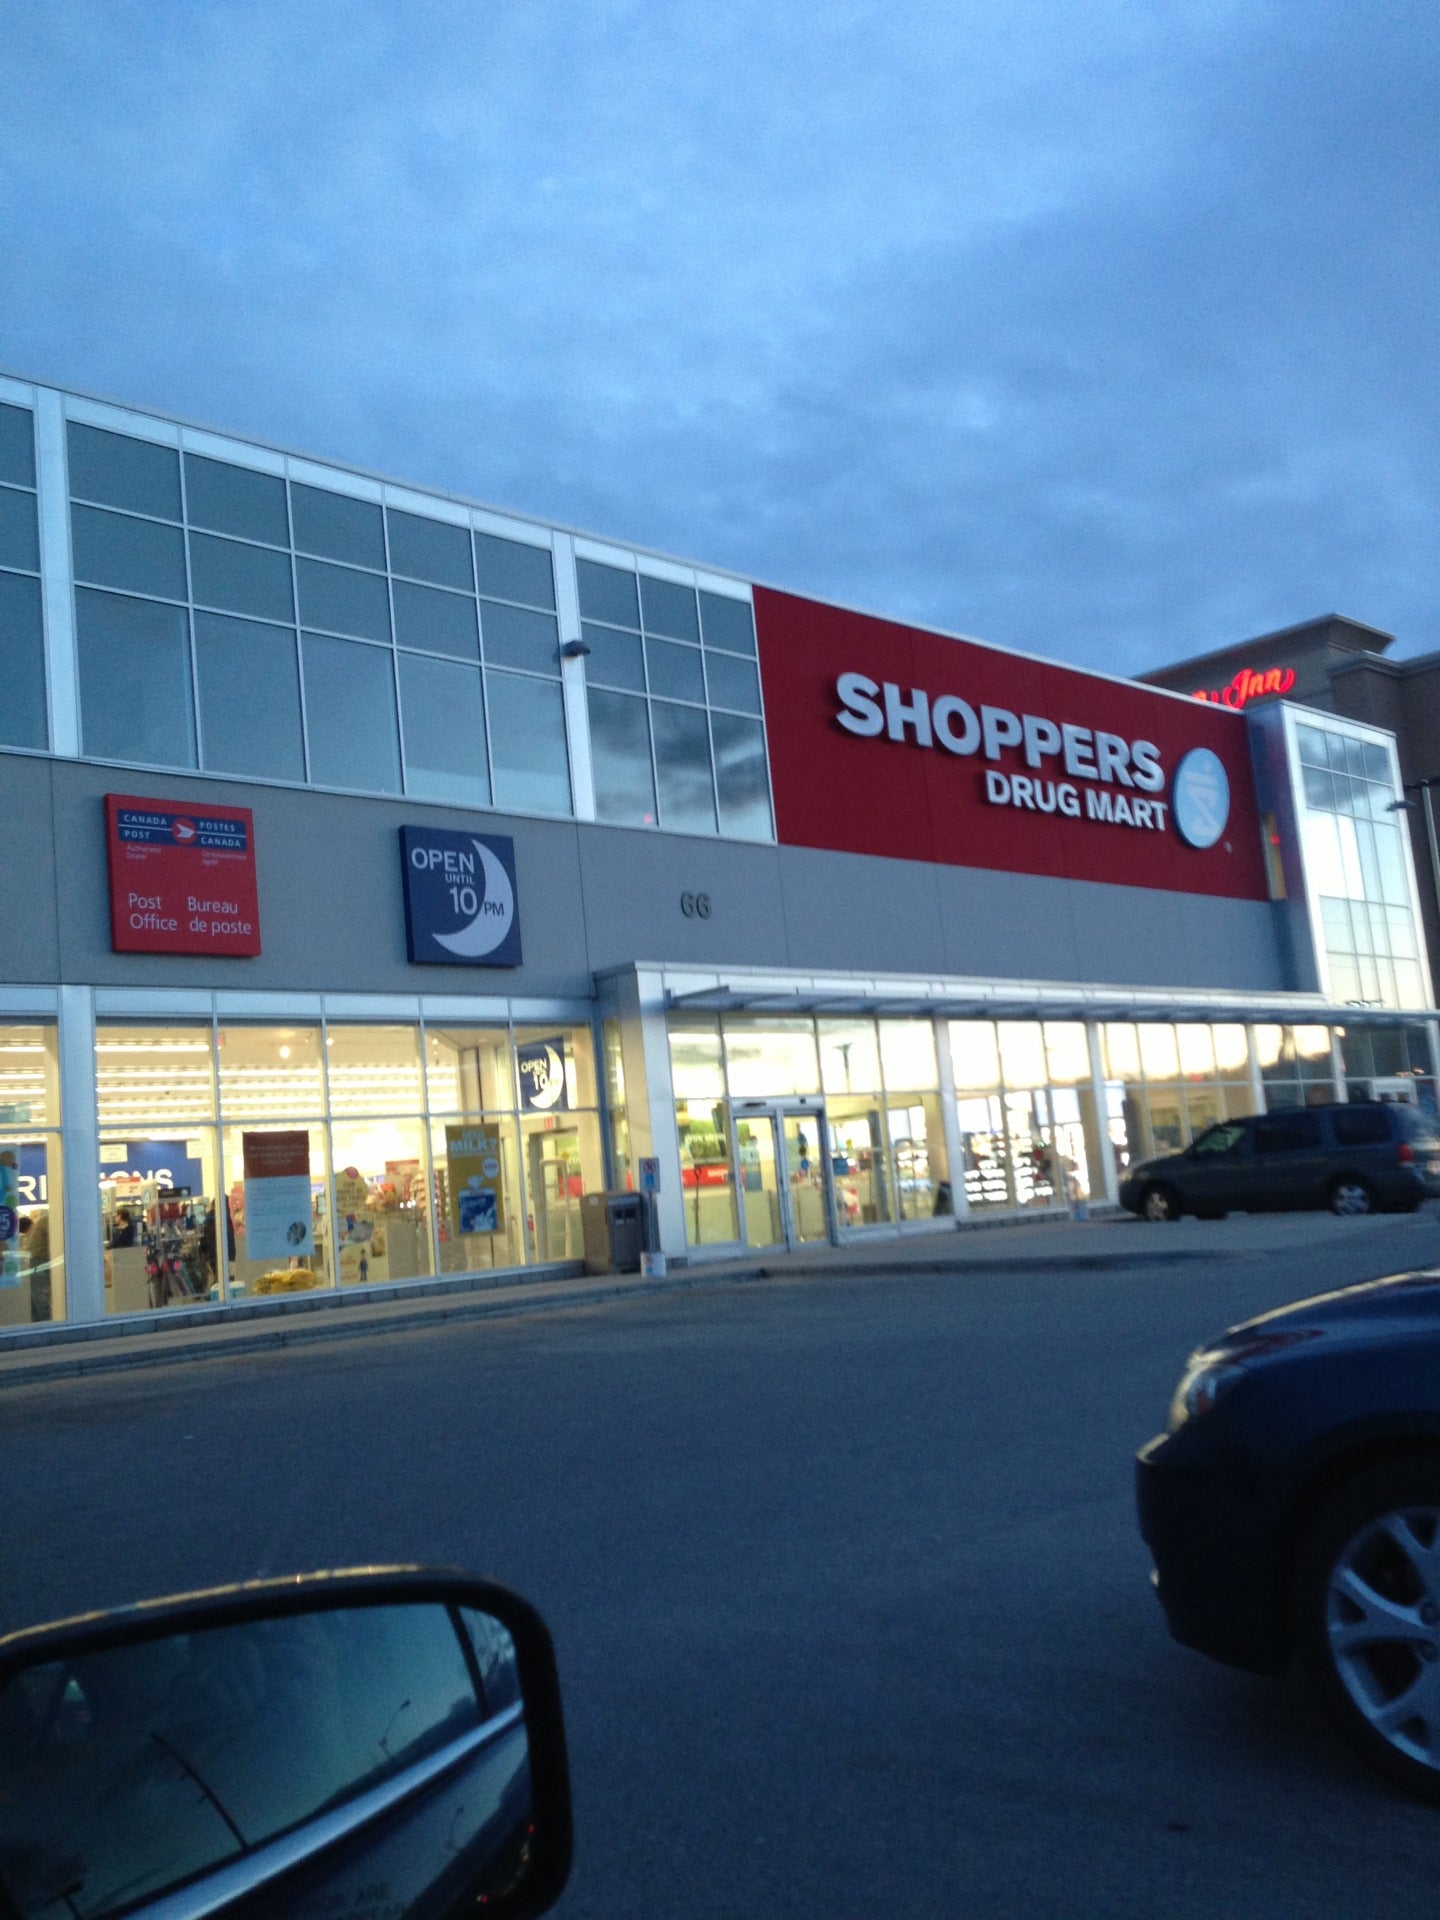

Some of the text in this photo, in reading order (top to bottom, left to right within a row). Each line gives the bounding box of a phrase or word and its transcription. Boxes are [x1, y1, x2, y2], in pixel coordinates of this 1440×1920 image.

[836, 671, 1166, 793] SHOPPERS
[985, 769, 1168, 832] DRUG MART
[124, 813, 168, 826] CANADA
[199, 821, 236, 833] POSTES
[124, 829, 151, 840] POST
[200, 836, 242, 848] CANADA
[411, 847, 475, 874] OPEN
[445, 873, 476, 885] UNTIL
[127, 892, 163, 910] Post
[187, 896, 239, 915] Bureau
[449, 886, 505, 917] 10 PM
[681, 891, 711, 920] 66
[130, 913, 178, 931] Office
[189, 917, 252, 936] de poste
[521, 1057, 547, 1074] OPEN
